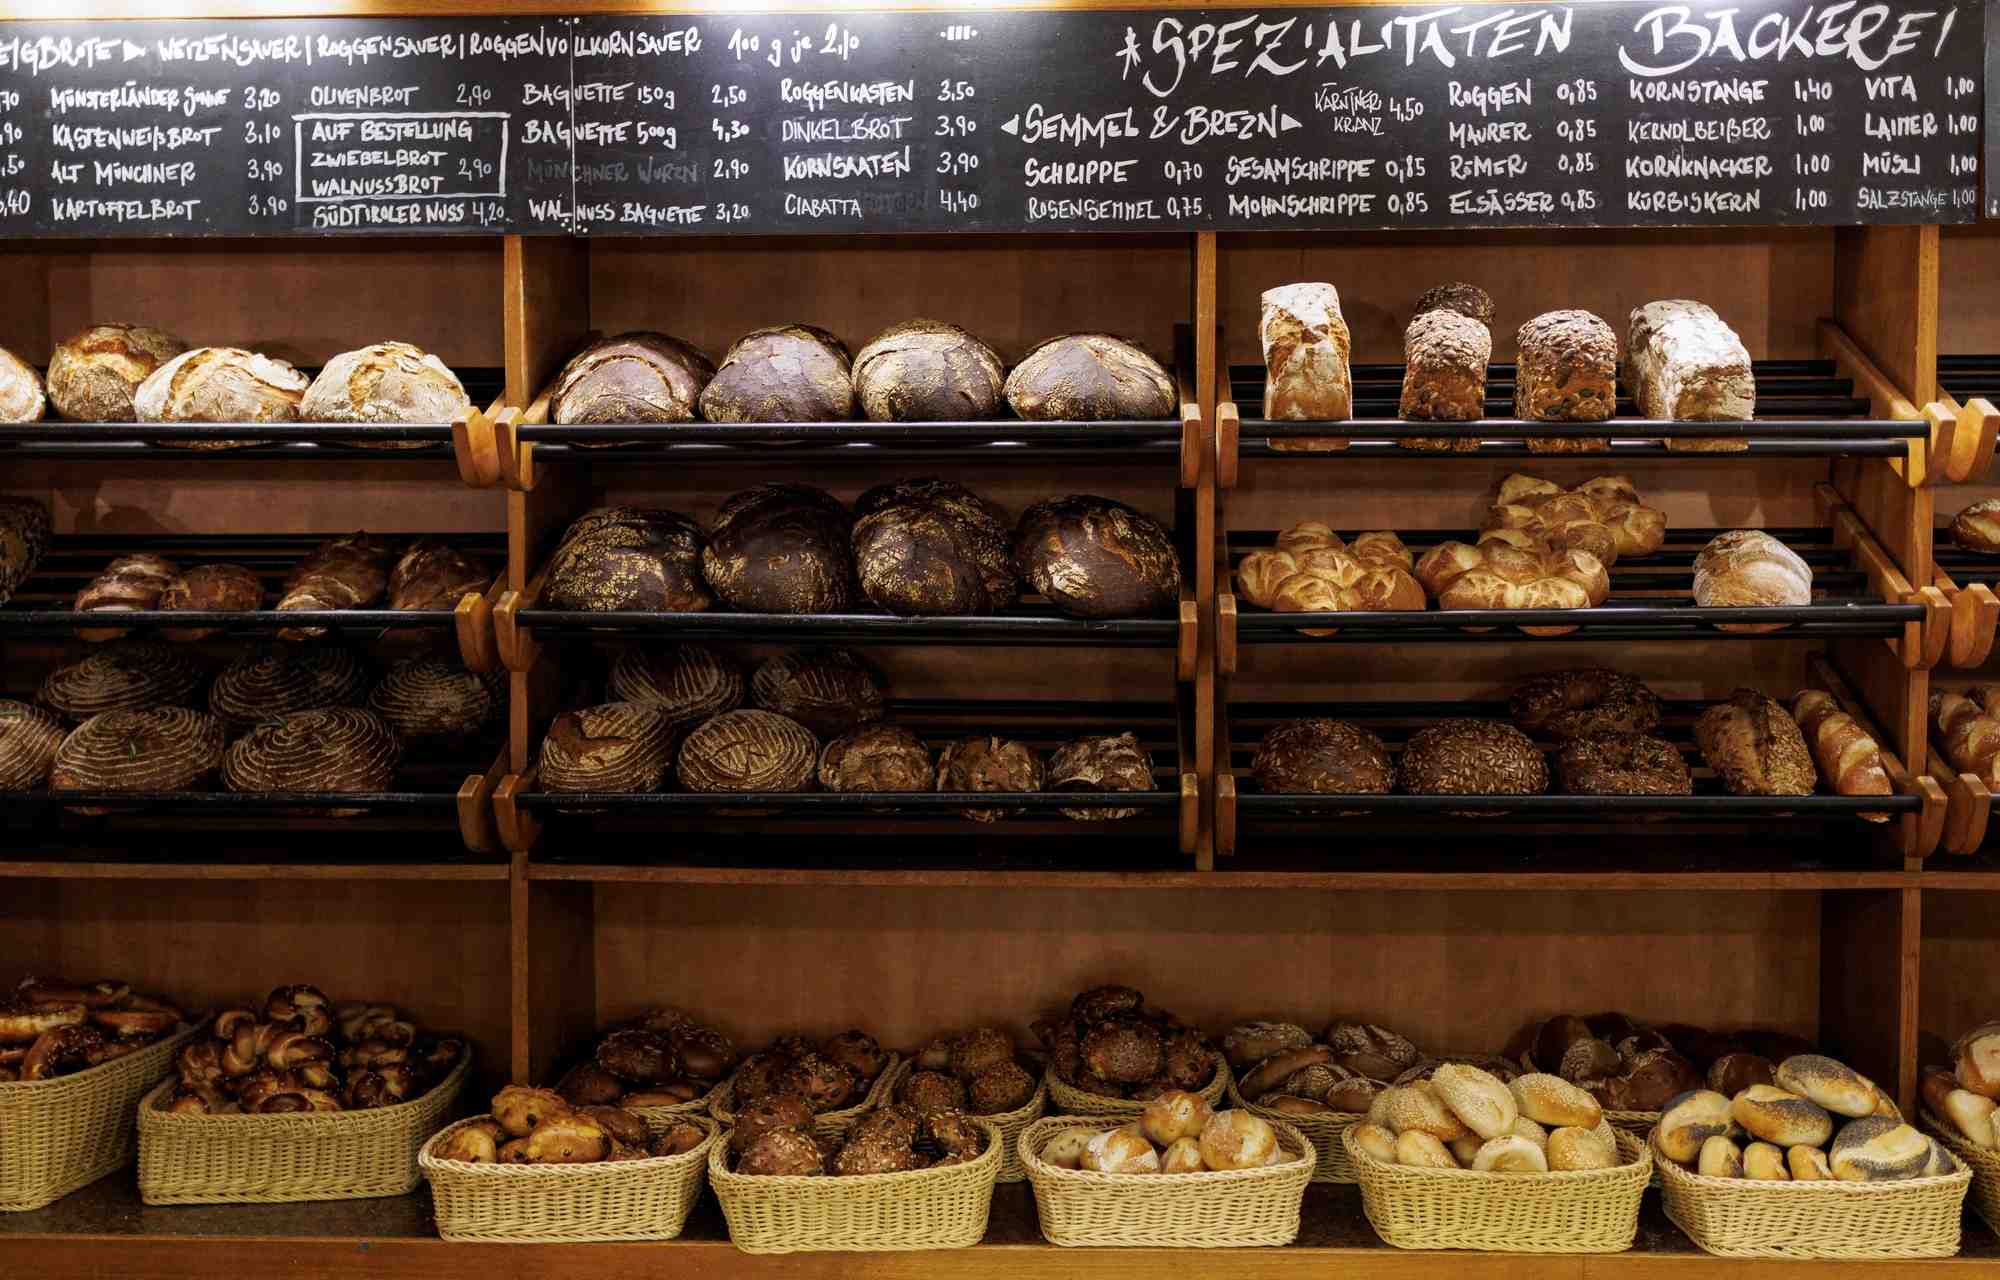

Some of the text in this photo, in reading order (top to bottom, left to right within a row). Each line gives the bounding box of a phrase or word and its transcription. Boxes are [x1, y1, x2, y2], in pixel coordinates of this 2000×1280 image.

[157, 33, 302, 66] WEIZENSAUER
[318, 35, 456, 65] ROGGENSAUER
[728, 28, 760, 61] 100
[767, 39, 782, 68] g
[791, 30, 812, 64] je
[819, 23, 860, 61] 2,10
[1618, 3, 1958, 77] BÄCKEREI
[50, 81, 180, 114] MÜNSTERLÄNDER
[244, 86, 281, 111] 3,20
[310, 83, 491, 109] OLIVENBROT 2,90
[522, 82, 747, 111] BAGUETTE 150g 2,50
[781, 77, 975, 112] ROGGENKASTEN 3,50
[1448, 78, 1598, 116] ROGGEN 0,85
[1630, 76, 1833, 105] KORNSTANGE 1,40
[1865, 75, 1918, 102] VITA
[1390, 97, 1424, 122] 4,50
[244, 120, 281, 144] 3,10
[311, 119, 473, 143] AUF BESTELLUNG
[521, 118, 750, 150] BAGUETTE 500g 4,30
[781, 115, 977, 143] DINKELBROT 3,90
[1022, 103, 1279, 148] SEMMEL & BREZN
[1334, 116, 1385, 136] KRANZ
[1449, 118, 1597, 148] MAURER 0,85
[1797, 114, 1825, 136] 1,00
[1948, 113, 1978, 136] 1,00
[50, 159, 284, 187] ALT MÜNCHNER 3,90
[310, 150, 492, 183] ZWIEBELBROT 2,90
[713, 158, 750, 181] 2,90
[783, 145, 979, 182] KORNSAATEN 3,90
[1024, 158, 1203, 187] SCHRIPPE 0,70
[1225, 155, 1426, 186] SESAMSCHRIPPE 0,85
[1449, 152, 1594, 180] RÖMER 0,85
[1625, 150, 1831, 180] KORNKNACKER 1,00
[1863, 151, 1978, 177] MÜSLI 1,00
[311, 175, 446, 196] WALNUSSBROT
[1857, 186, 1976, 210] SALZSTANGE 1,00
[52, 197, 287, 222] KARTOFFELBROT 3,90
[620, 202, 707, 226] BAGUETTE
[784, 193, 863, 218] CIABATTA
[940, 190, 977, 213] 4,40
[1028, 196, 1202, 221] ROSENSEMMEL 0,75
[1228, 192, 1428, 219] MOHNSCHRIPPE 0,85
[1448, 188, 1596, 216] ELSÄSSER 0,85
[1627, 187, 1828, 214] KÜRBISKERN 1,00
[313, 202, 422, 229] SÜDTIROLER
[426, 202, 465, 222] NUSS
